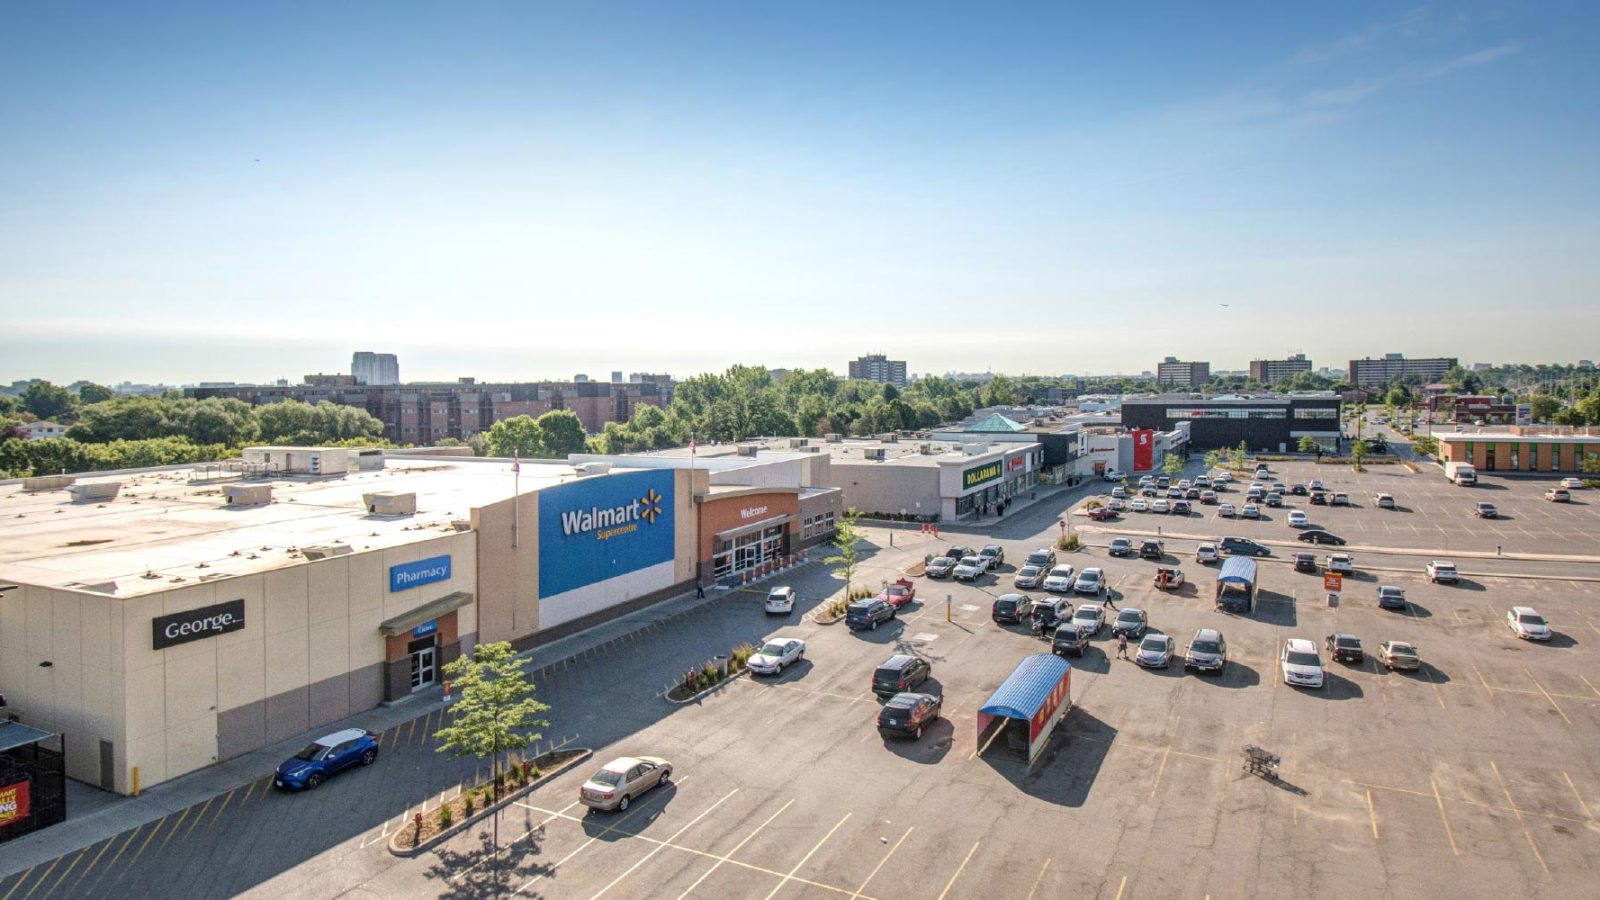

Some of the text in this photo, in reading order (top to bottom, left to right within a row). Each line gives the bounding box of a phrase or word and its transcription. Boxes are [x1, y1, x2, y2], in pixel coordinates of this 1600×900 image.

[561, 498, 640, 536] Walmart
[740, 506, 768, 519] Welcome
[596, 523, 638, 541] Supercentre
[396, 565, 448, 585] Pharmacy
